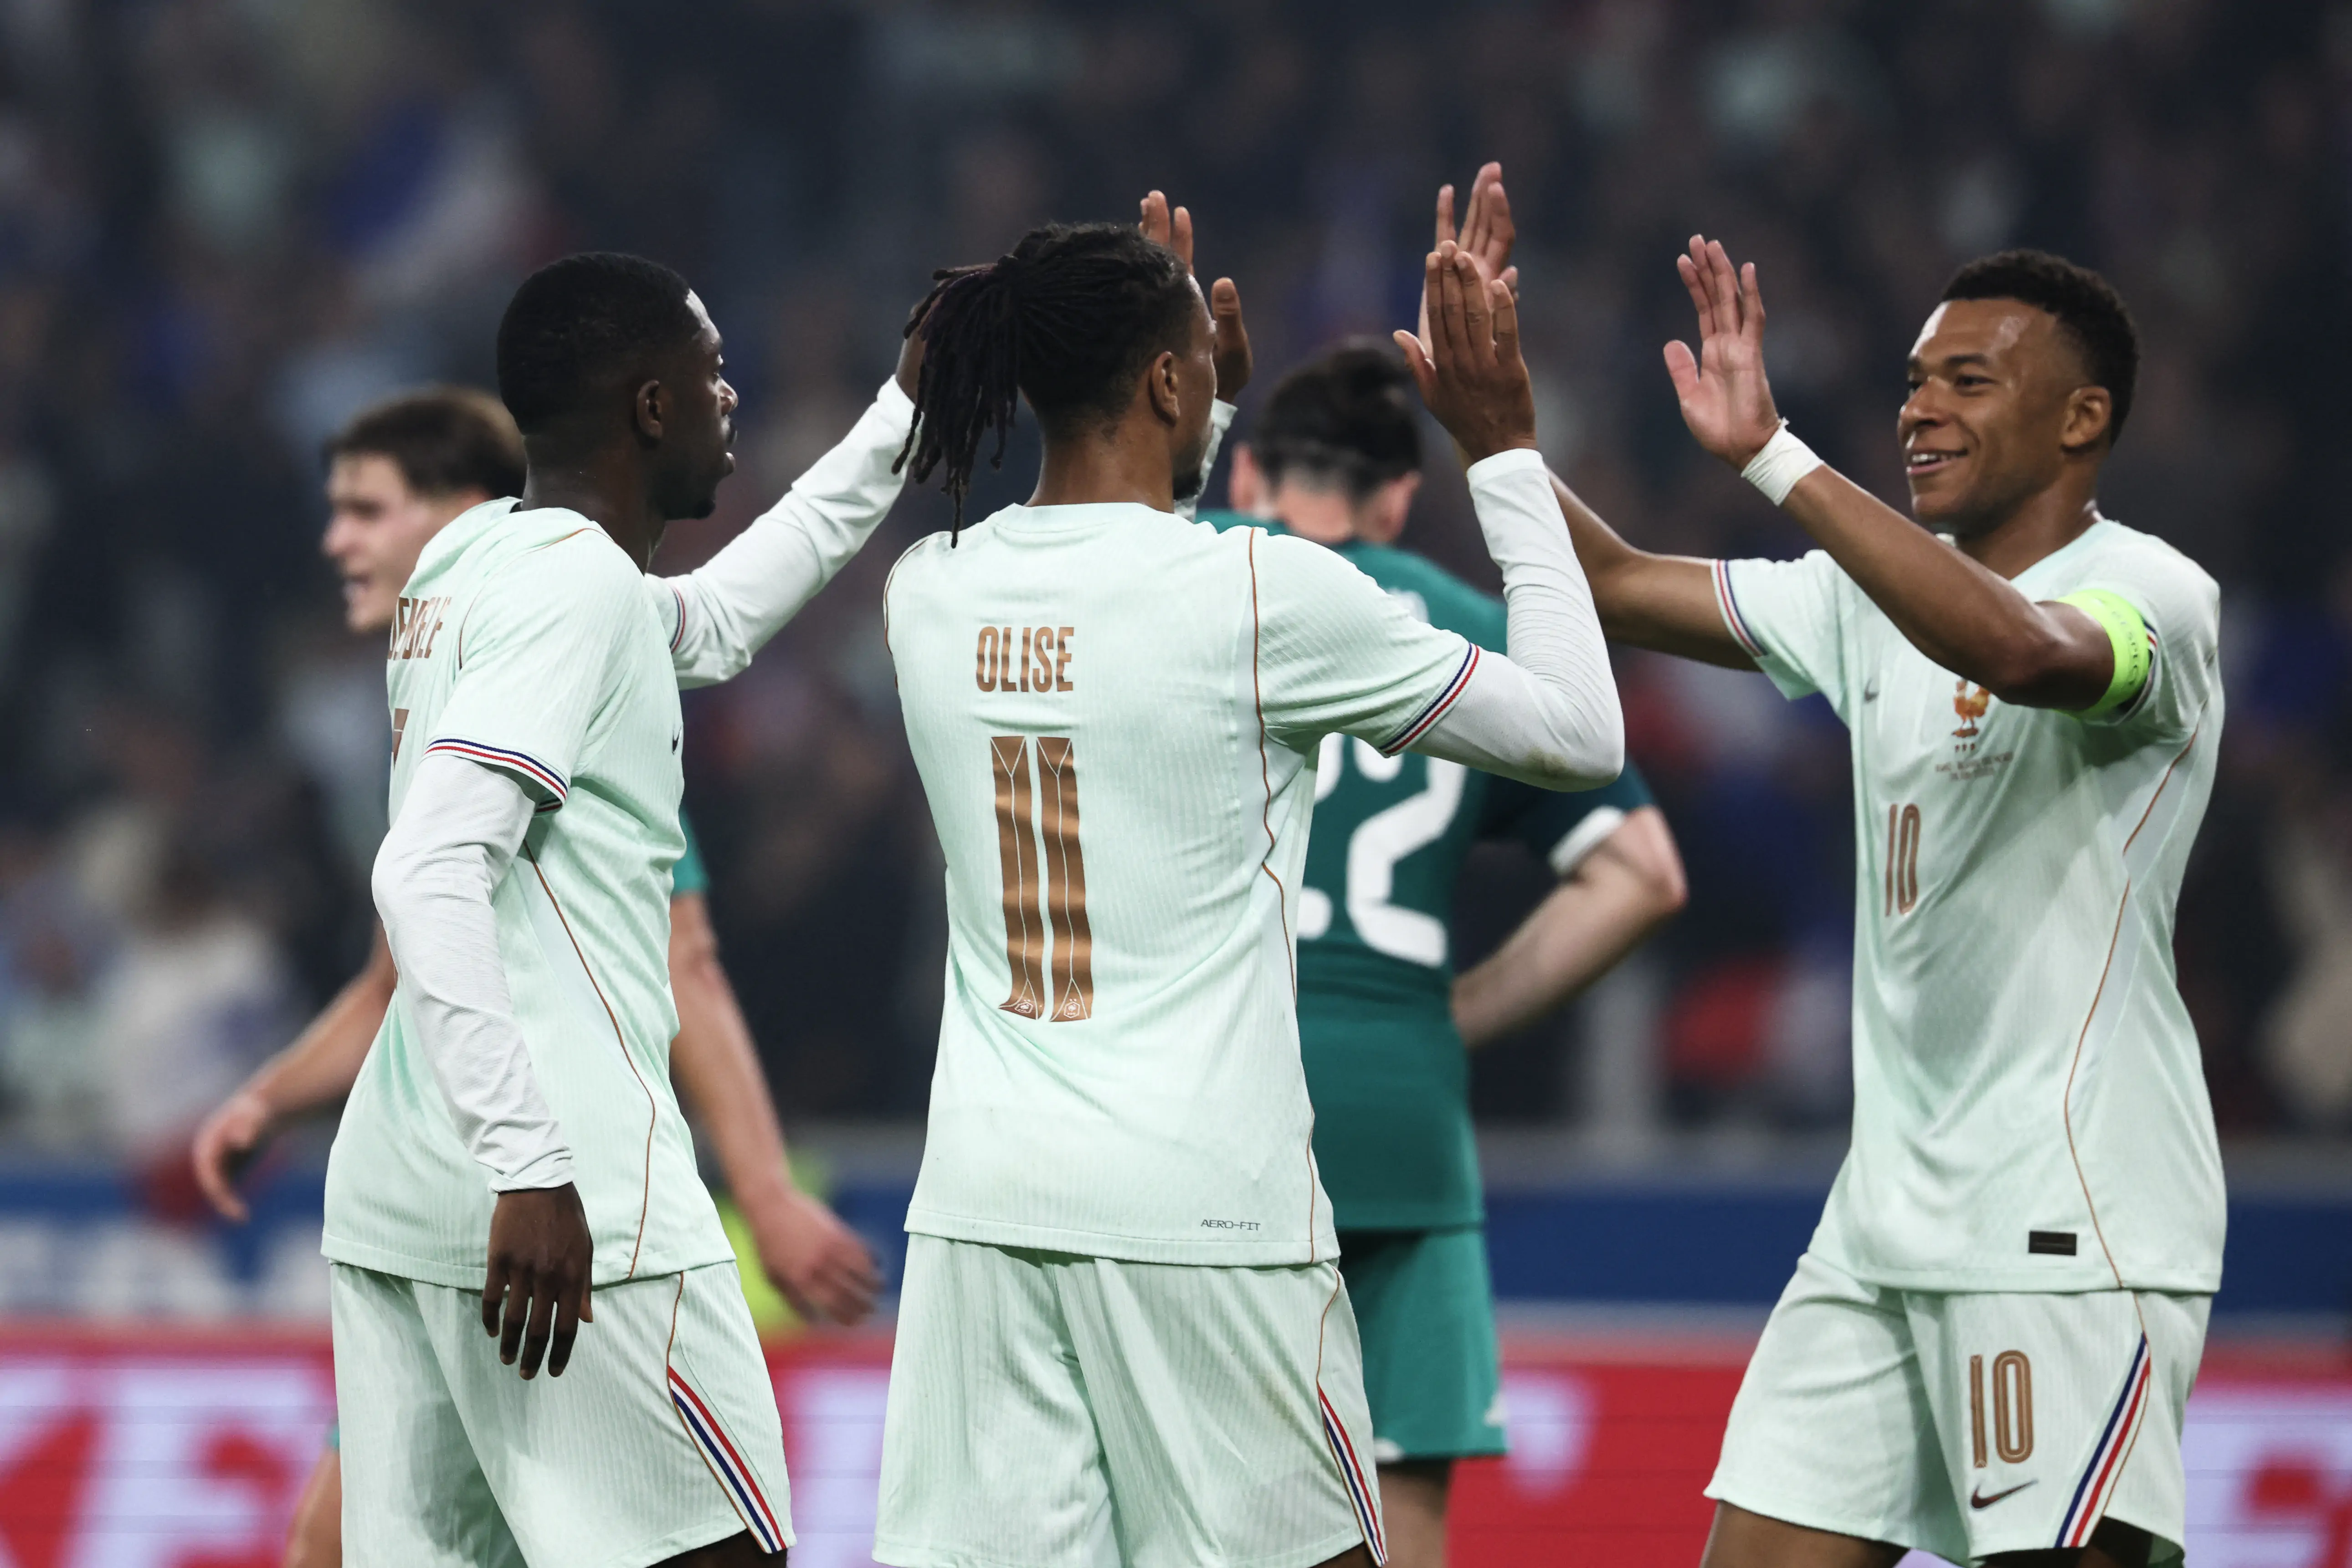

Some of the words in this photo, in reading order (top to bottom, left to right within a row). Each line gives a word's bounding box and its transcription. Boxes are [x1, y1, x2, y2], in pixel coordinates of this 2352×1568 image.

[976, 626, 1074, 693] OLISE
[990, 735, 1094, 1022] 11
[1885, 803, 1921, 917] 10
[1200, 1218, 1261, 1231] AERO-FIT
[1970, 1350, 2034, 1468] 10
